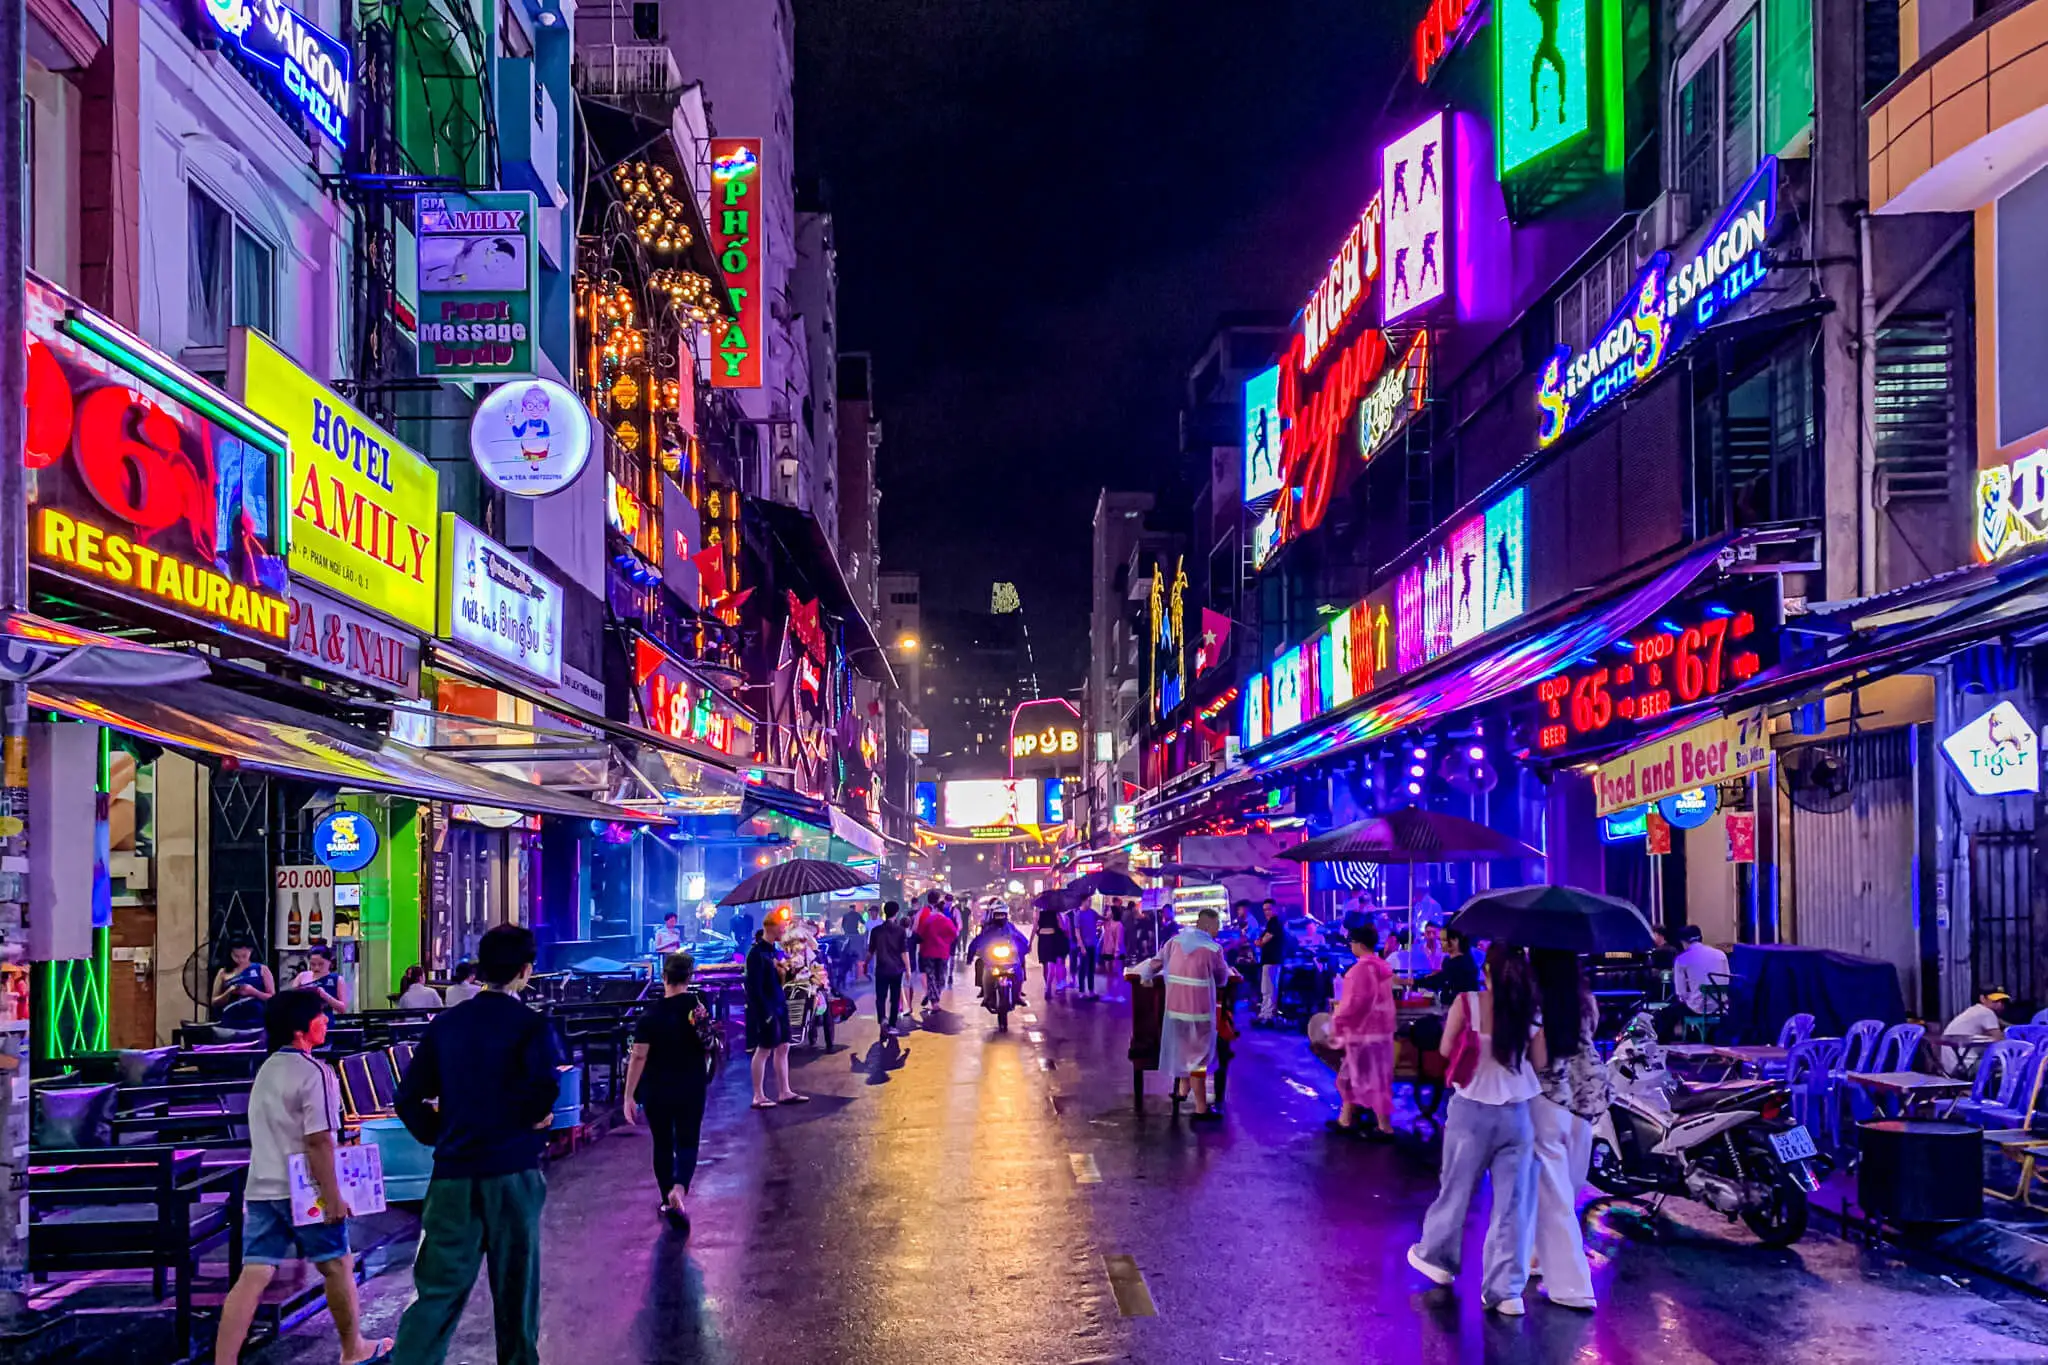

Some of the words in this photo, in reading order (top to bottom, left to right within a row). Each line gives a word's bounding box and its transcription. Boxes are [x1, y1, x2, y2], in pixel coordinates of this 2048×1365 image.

[263, 0, 349, 118] SAIGON
[284, 57, 346, 148] CHILL
[421, 211, 522, 231] FAMILY
[1679, 199, 1767, 305] SAIGON
[421, 323, 526, 342] Massage
[1573, 318, 1638, 390] SAIGO
[312, 398, 394, 493] HOTEL
[290, 450, 430, 584] AMILY
[42, 508, 290, 639] RESTAURANT
[461, 595, 479, 625] Milk
[324, 613, 345, 663] &
[348, 623, 409, 687] NAIL
[1635, 632, 1675, 664] FOOD
[1677, 617, 1729, 700] 67
[1572, 667, 1612, 733] 65
[1637, 689, 1672, 718] BEER
[1539, 724, 1568, 750] BEER
[1969, 746, 2028, 776] Tiger
[1600, 759, 1637, 809] Food
[1641, 745, 1676, 796] and
[1681, 740, 1729, 784] Beer
[277, 869, 331, 889] 20.000
[326, 843, 359, 851] SAIGON
